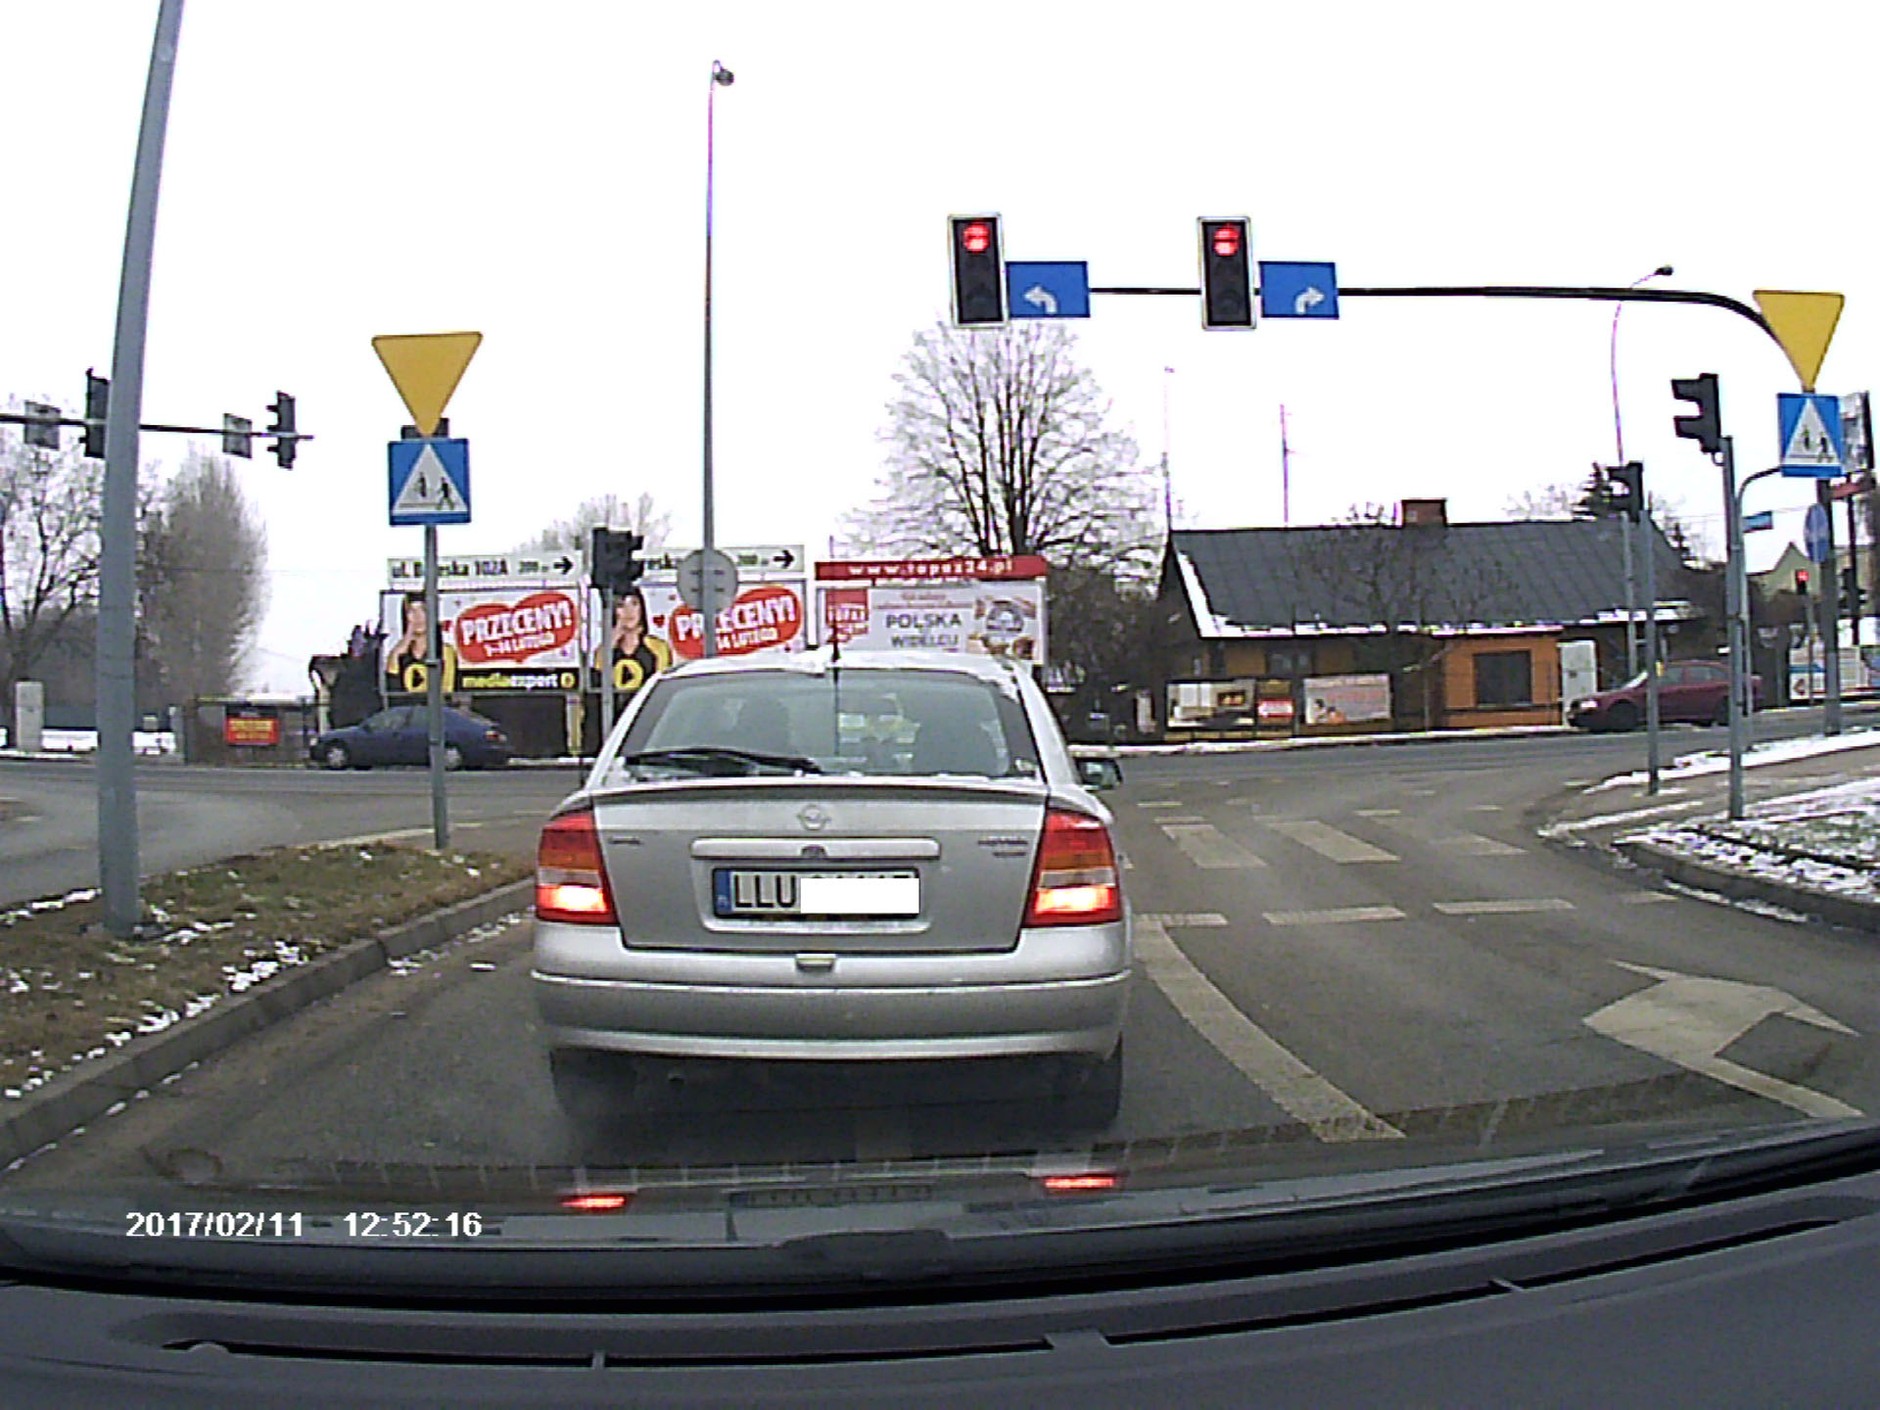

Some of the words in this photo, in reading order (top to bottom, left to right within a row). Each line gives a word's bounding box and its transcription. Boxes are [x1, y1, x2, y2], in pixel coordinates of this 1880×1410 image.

[461, 600, 573, 646] PRZECENY!
[675, 595, 797, 642] PRECENY!
[885, 612, 962, 628] POLSKA
[734, 874, 797, 908] LLU
